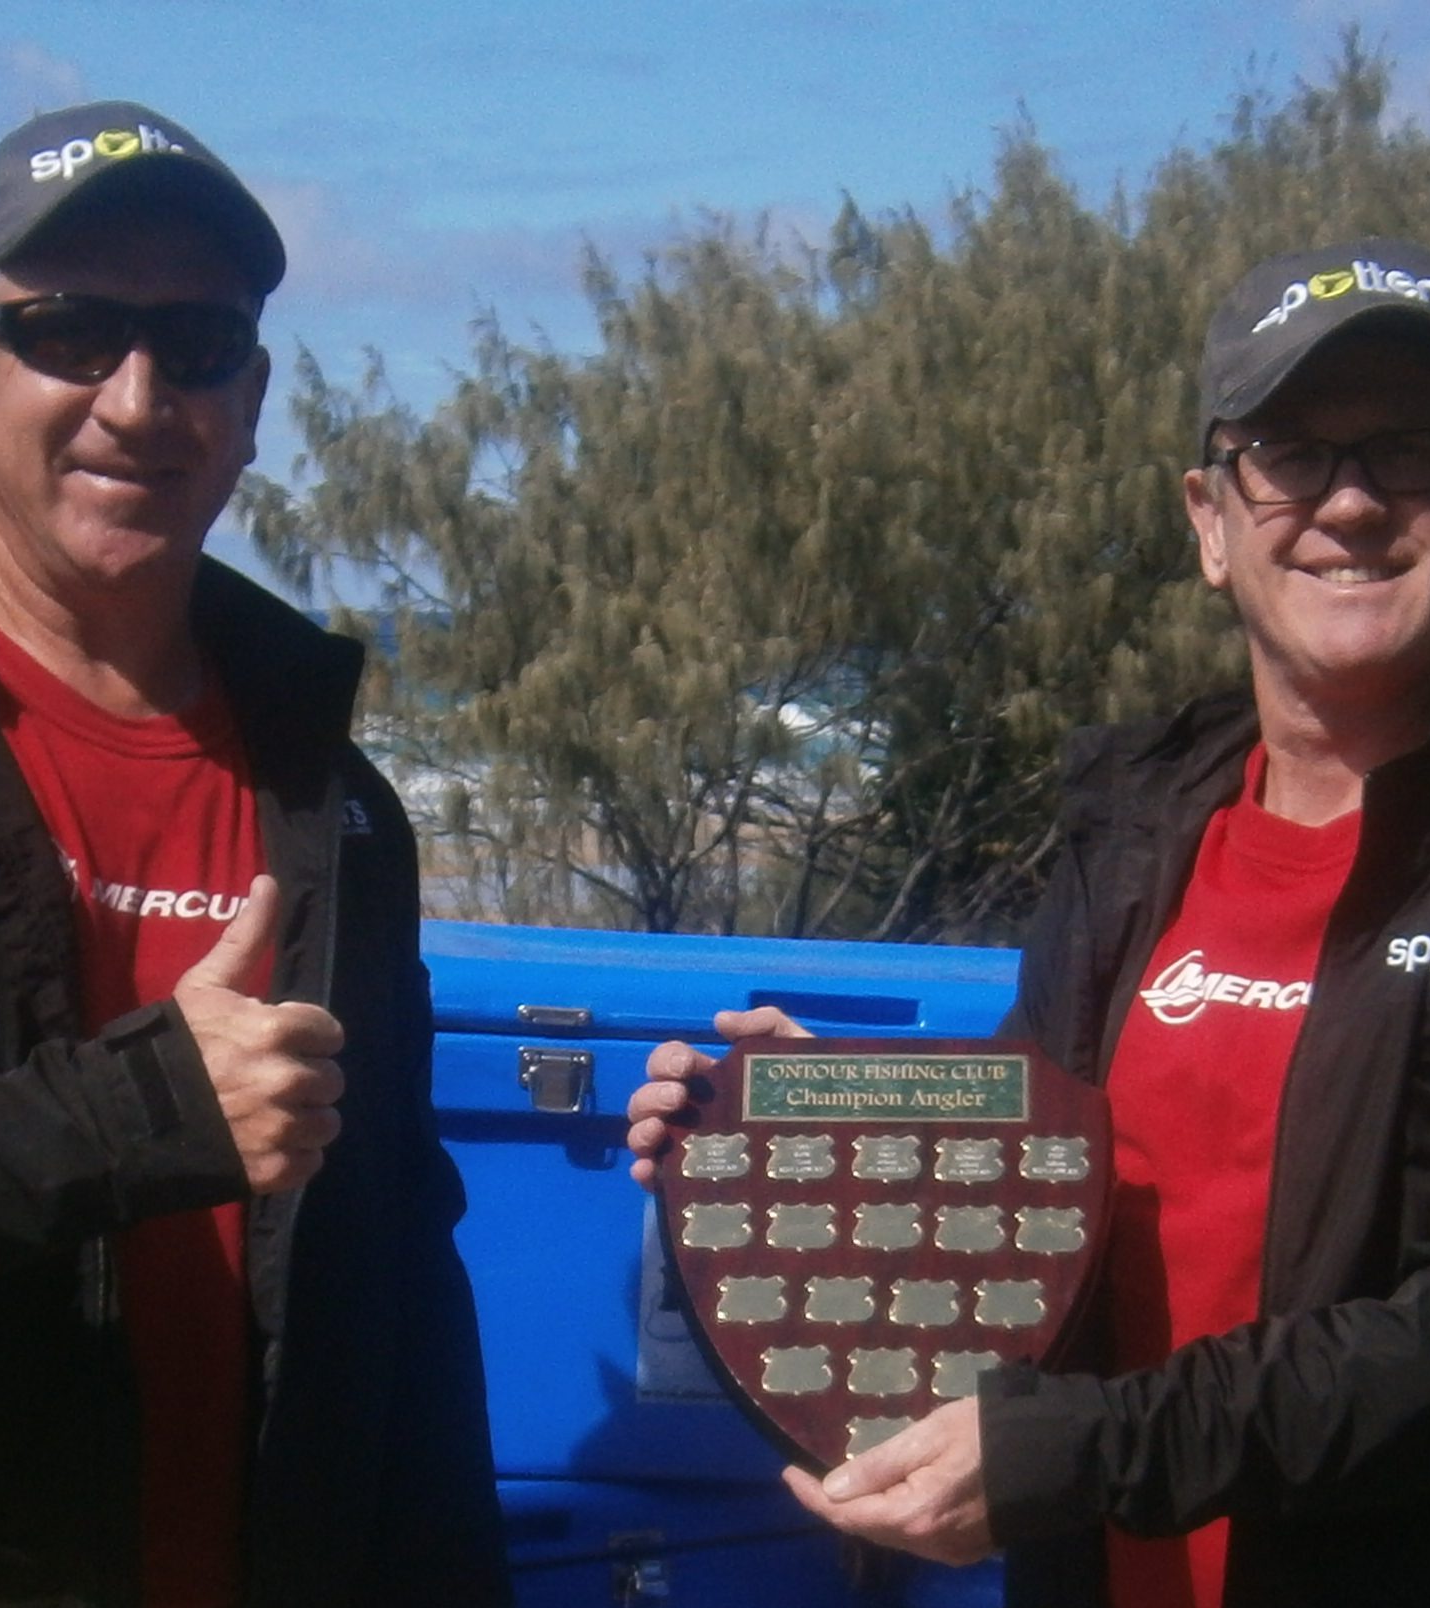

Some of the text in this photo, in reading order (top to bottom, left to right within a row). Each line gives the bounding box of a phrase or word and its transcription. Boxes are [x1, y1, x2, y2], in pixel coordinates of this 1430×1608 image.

[767, 1063, 1008, 1080] ONTOUR FISHING CLUB
[786, 1087, 988, 1112] Champion Angler
